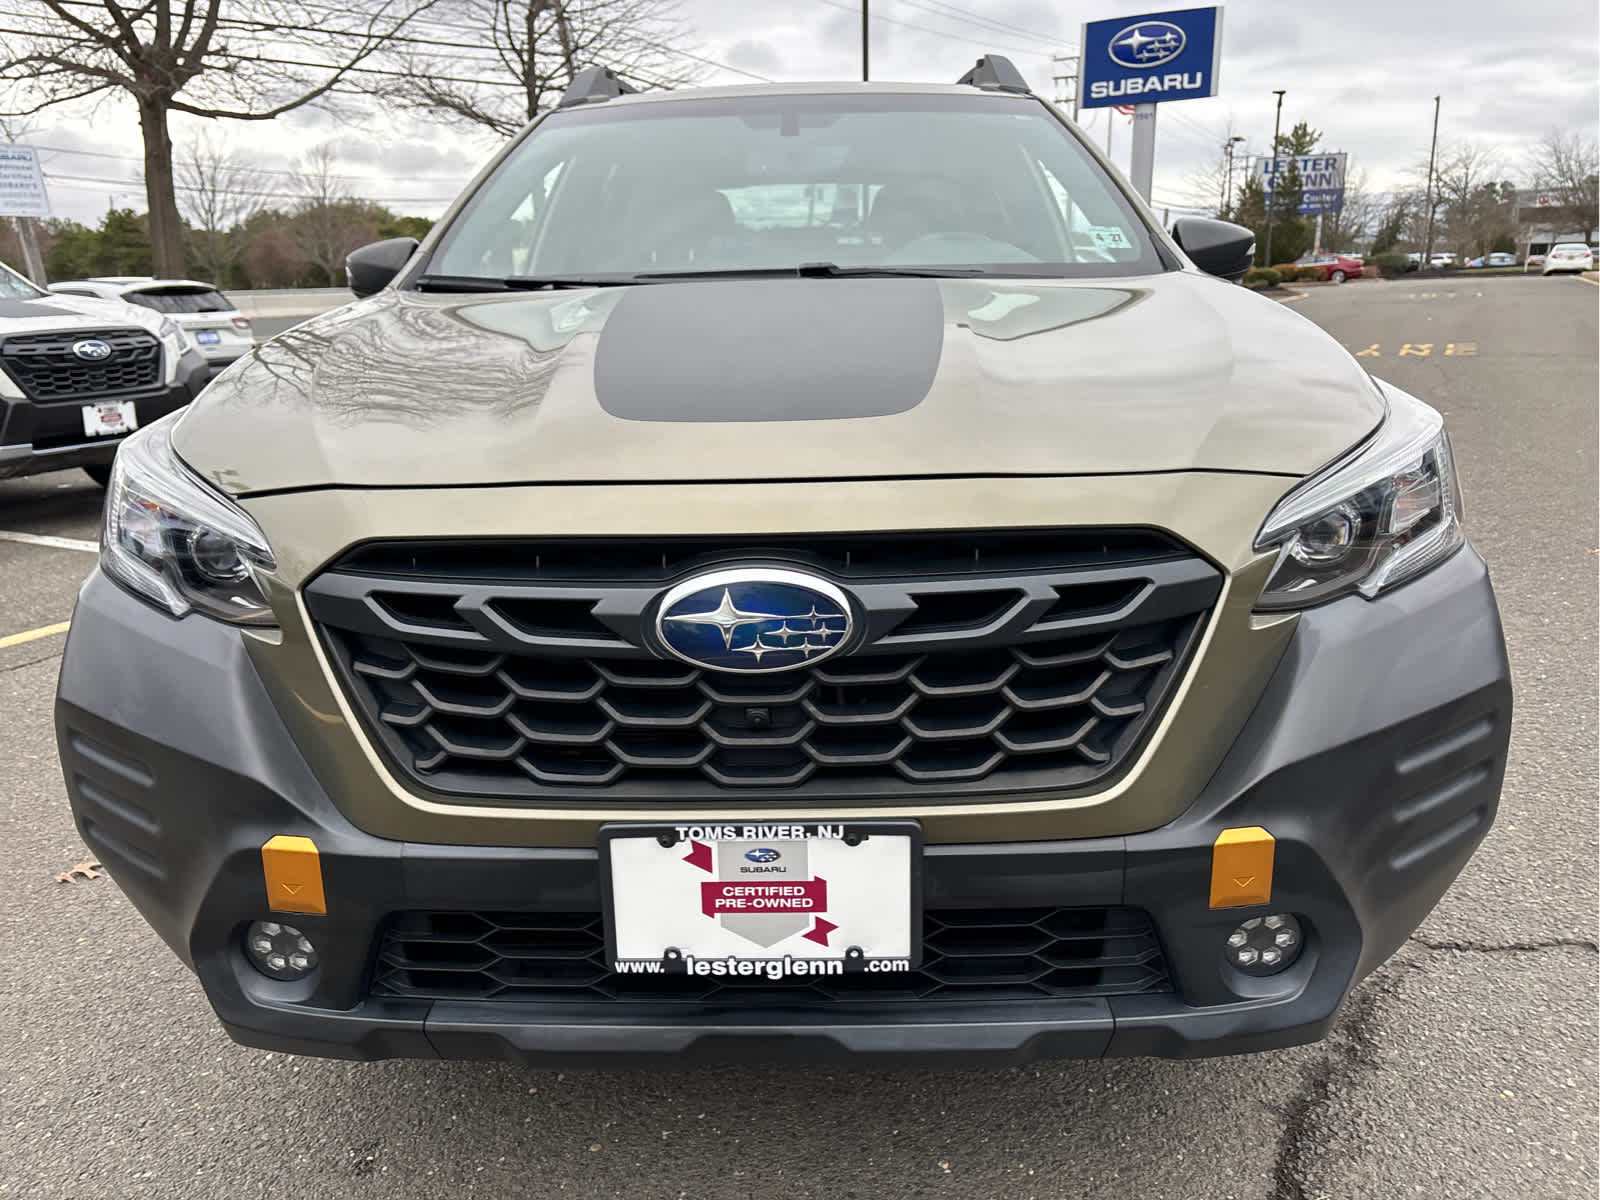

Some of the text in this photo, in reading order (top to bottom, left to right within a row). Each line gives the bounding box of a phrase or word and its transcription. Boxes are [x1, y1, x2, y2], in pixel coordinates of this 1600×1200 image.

[1090, 71, 1203, 98] SUBARU
[1264, 157, 1337, 174] LETER
[675, 825, 845, 841] TOMS RIVER, NJ
[722, 886, 806, 897] CERTIFIED
[714, 897, 814, 909] PRE-OWNED
[614, 956, 910, 980] www. lesterglenn .com
